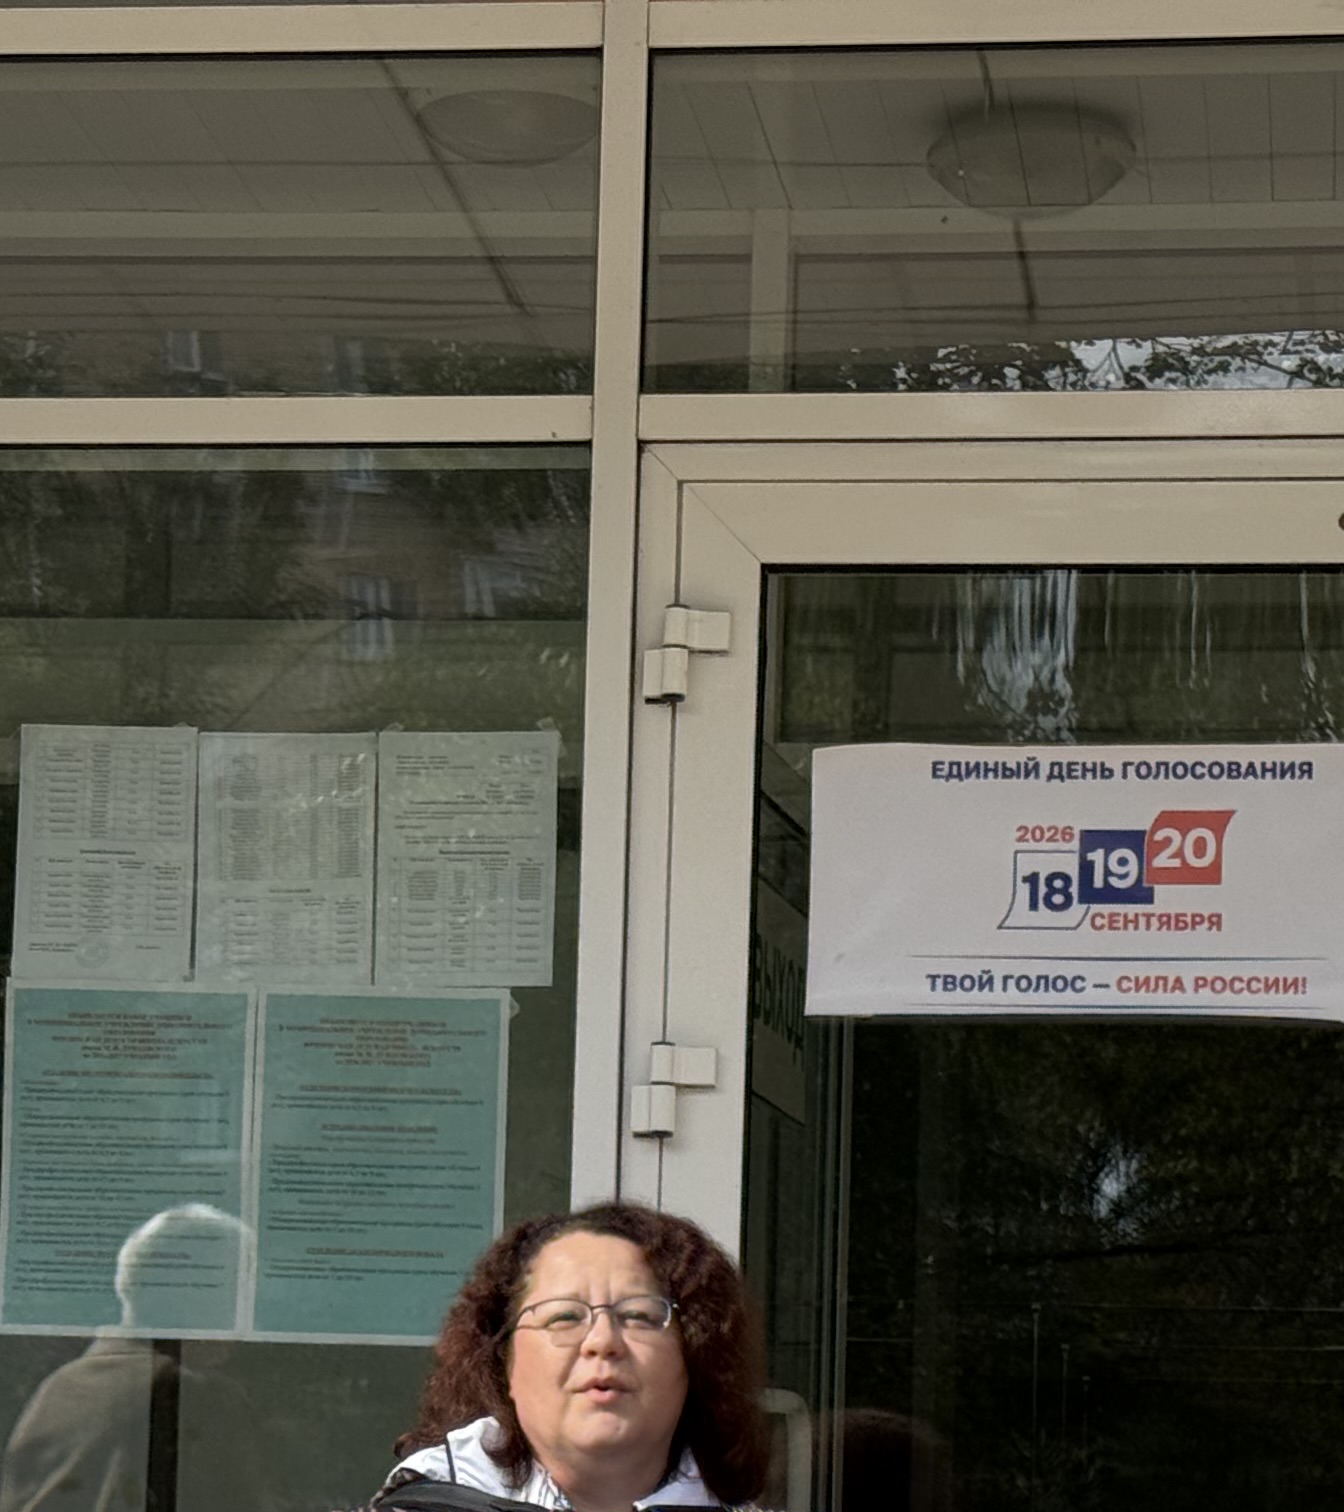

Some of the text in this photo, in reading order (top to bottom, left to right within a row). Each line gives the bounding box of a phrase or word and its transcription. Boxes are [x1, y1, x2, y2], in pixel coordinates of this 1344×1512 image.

[931, 756, 1314, 785] ЕДИНЫЙ ДЕНЬ ГОЛОСОВАНИЯ
[1015, 825, 1075, 844] 2026
[1021, 828, 1217, 913] 18 19 20
[1090, 911, 1223, 933] СЕНТЯБРЯ
[926, 971, 997, 994] ТВОЙ
[1002, 974, 1086, 995] ГОЛОС
[1116, 974, 1186, 995] СИЛА
[1193, 975, 1308, 996] РОССИИ!
